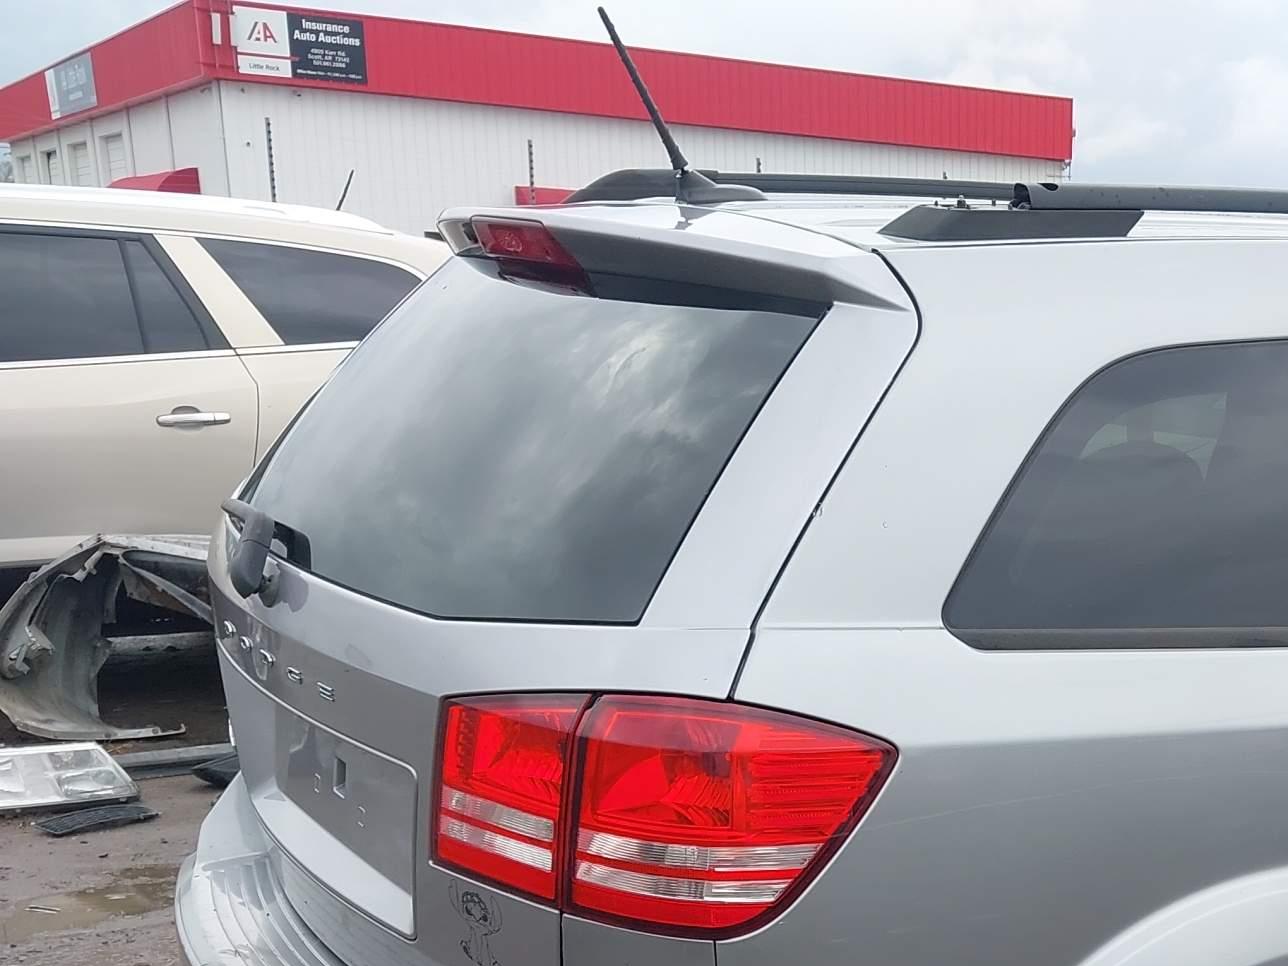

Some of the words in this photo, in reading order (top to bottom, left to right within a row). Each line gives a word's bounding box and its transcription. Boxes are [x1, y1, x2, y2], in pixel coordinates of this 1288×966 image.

[302, 19, 350, 33] Insurance
[293, 30, 316, 42] Auto
[318, 32, 361, 46] Auctions
[248, 62, 264, 70] Little
[265, 63, 280, 71] Rock
